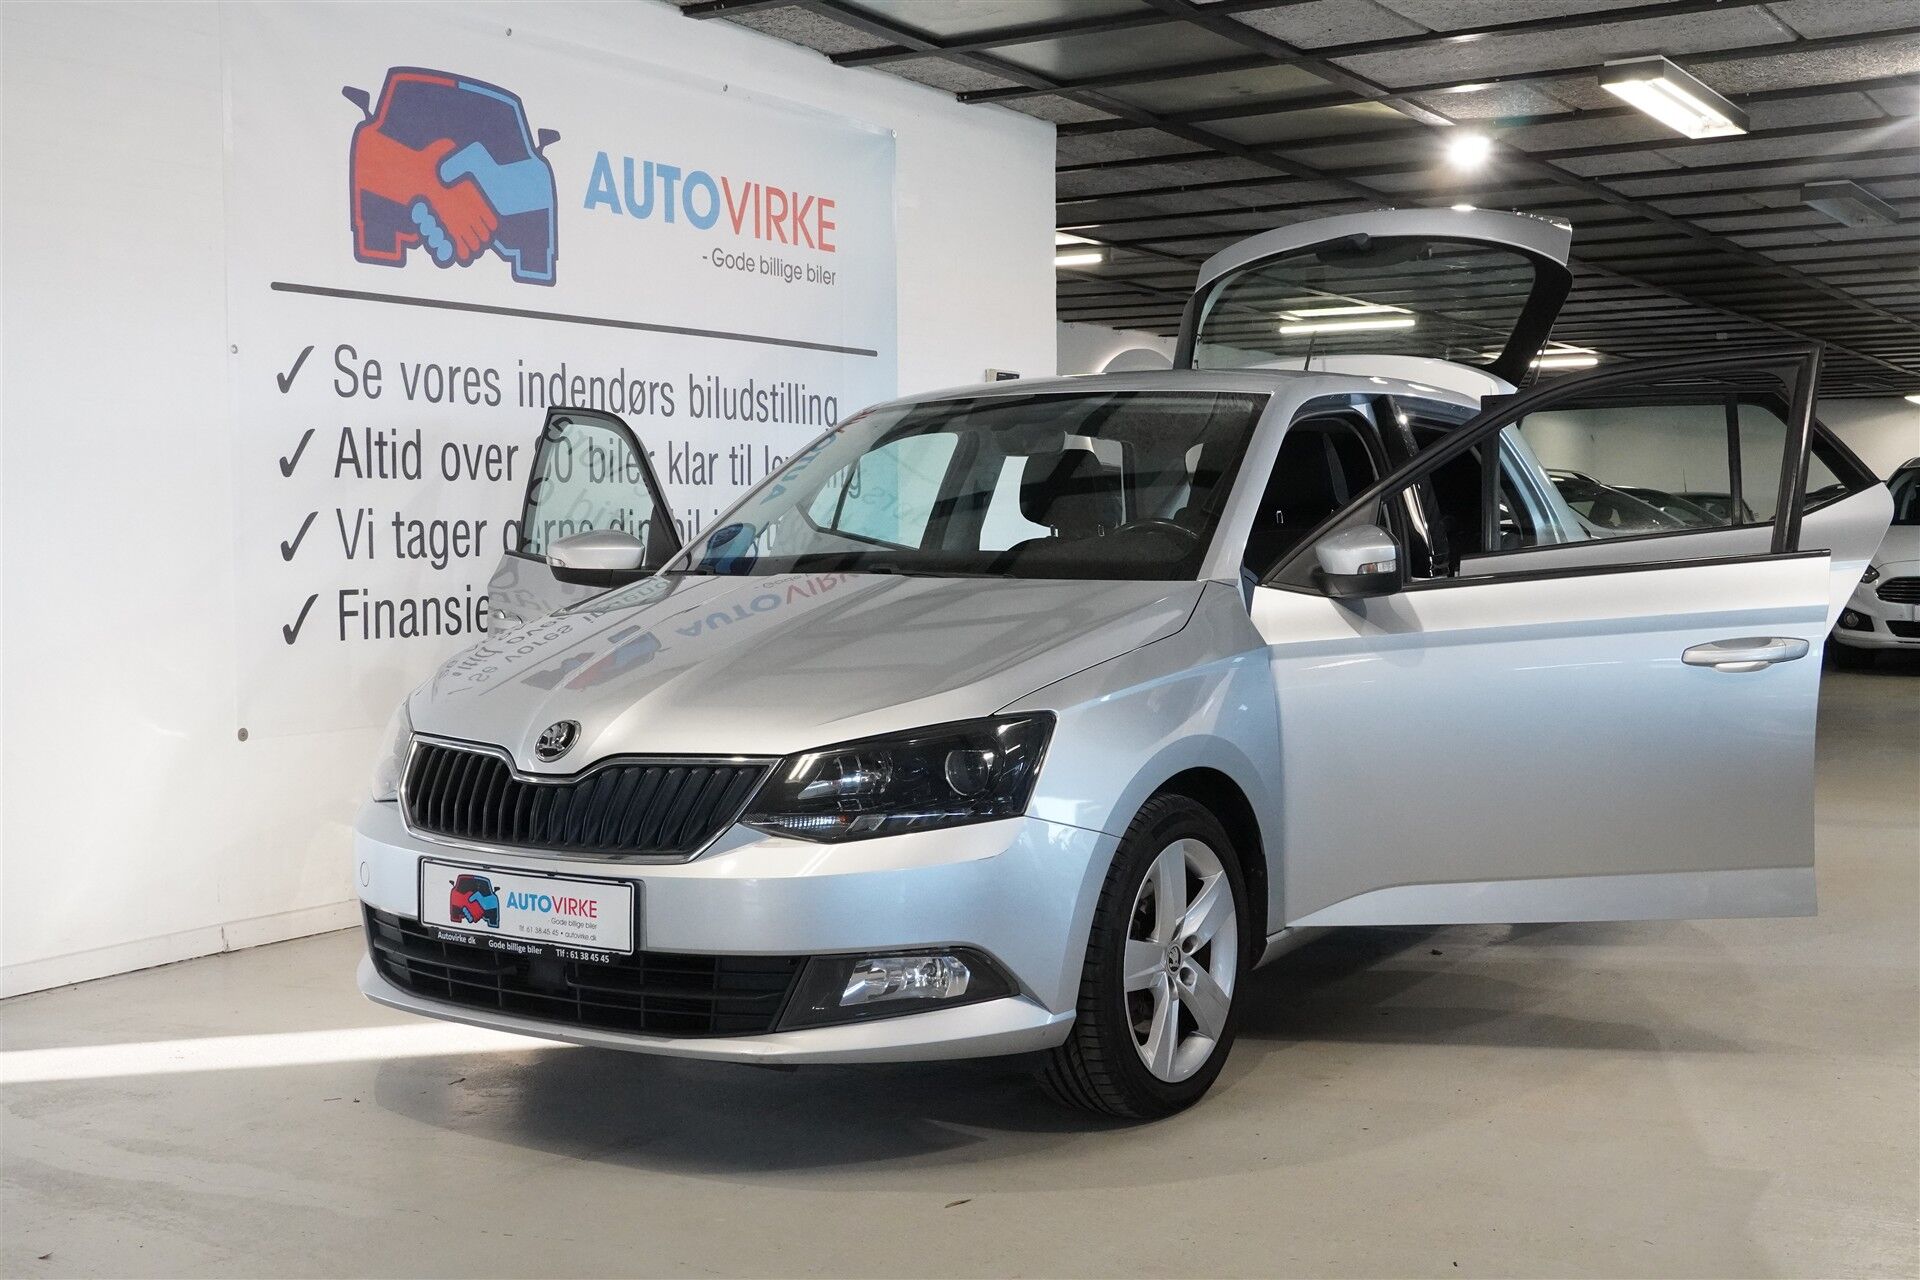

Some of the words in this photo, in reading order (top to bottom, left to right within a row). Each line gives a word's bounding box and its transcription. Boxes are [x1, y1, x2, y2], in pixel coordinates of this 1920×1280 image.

[584, 151, 836, 253] AUTOVIRKE
[711, 247, 756, 274] Gode
[759, 254, 802, 284] billige
[806, 263, 836, 286] biler
[335, 344, 381, 401] Se
[401, 363, 501, 409] vores
[518, 359, 675, 418] indendørs
[689, 373, 838, 431] biludstilling
[335, 426, 421, 481] Altid
[442, 443, 518, 486] over
[668, 441, 718, 485] klar
[729, 446, 752, 486] til
[336, 508, 374, 560] Vi
[391, 511, 487, 572] tager
[506, 891, 598, 919] AUTOVIRKE
[551, 917, 567, 926] Gode
[568, 920, 584, 930] billige
[585, 922, 597, 930] biler
[488, 939, 506, 950] Gode
[506, 942, 526, 954] billige
[527, 945, 542, 955] biler
[555, 948, 565, 957] Tlf
[570, 950, 578, 959] 61
[580, 952, 589, 961] 38
[590, 953, 599, 962] 45
[600, 955, 610, 963] 45
